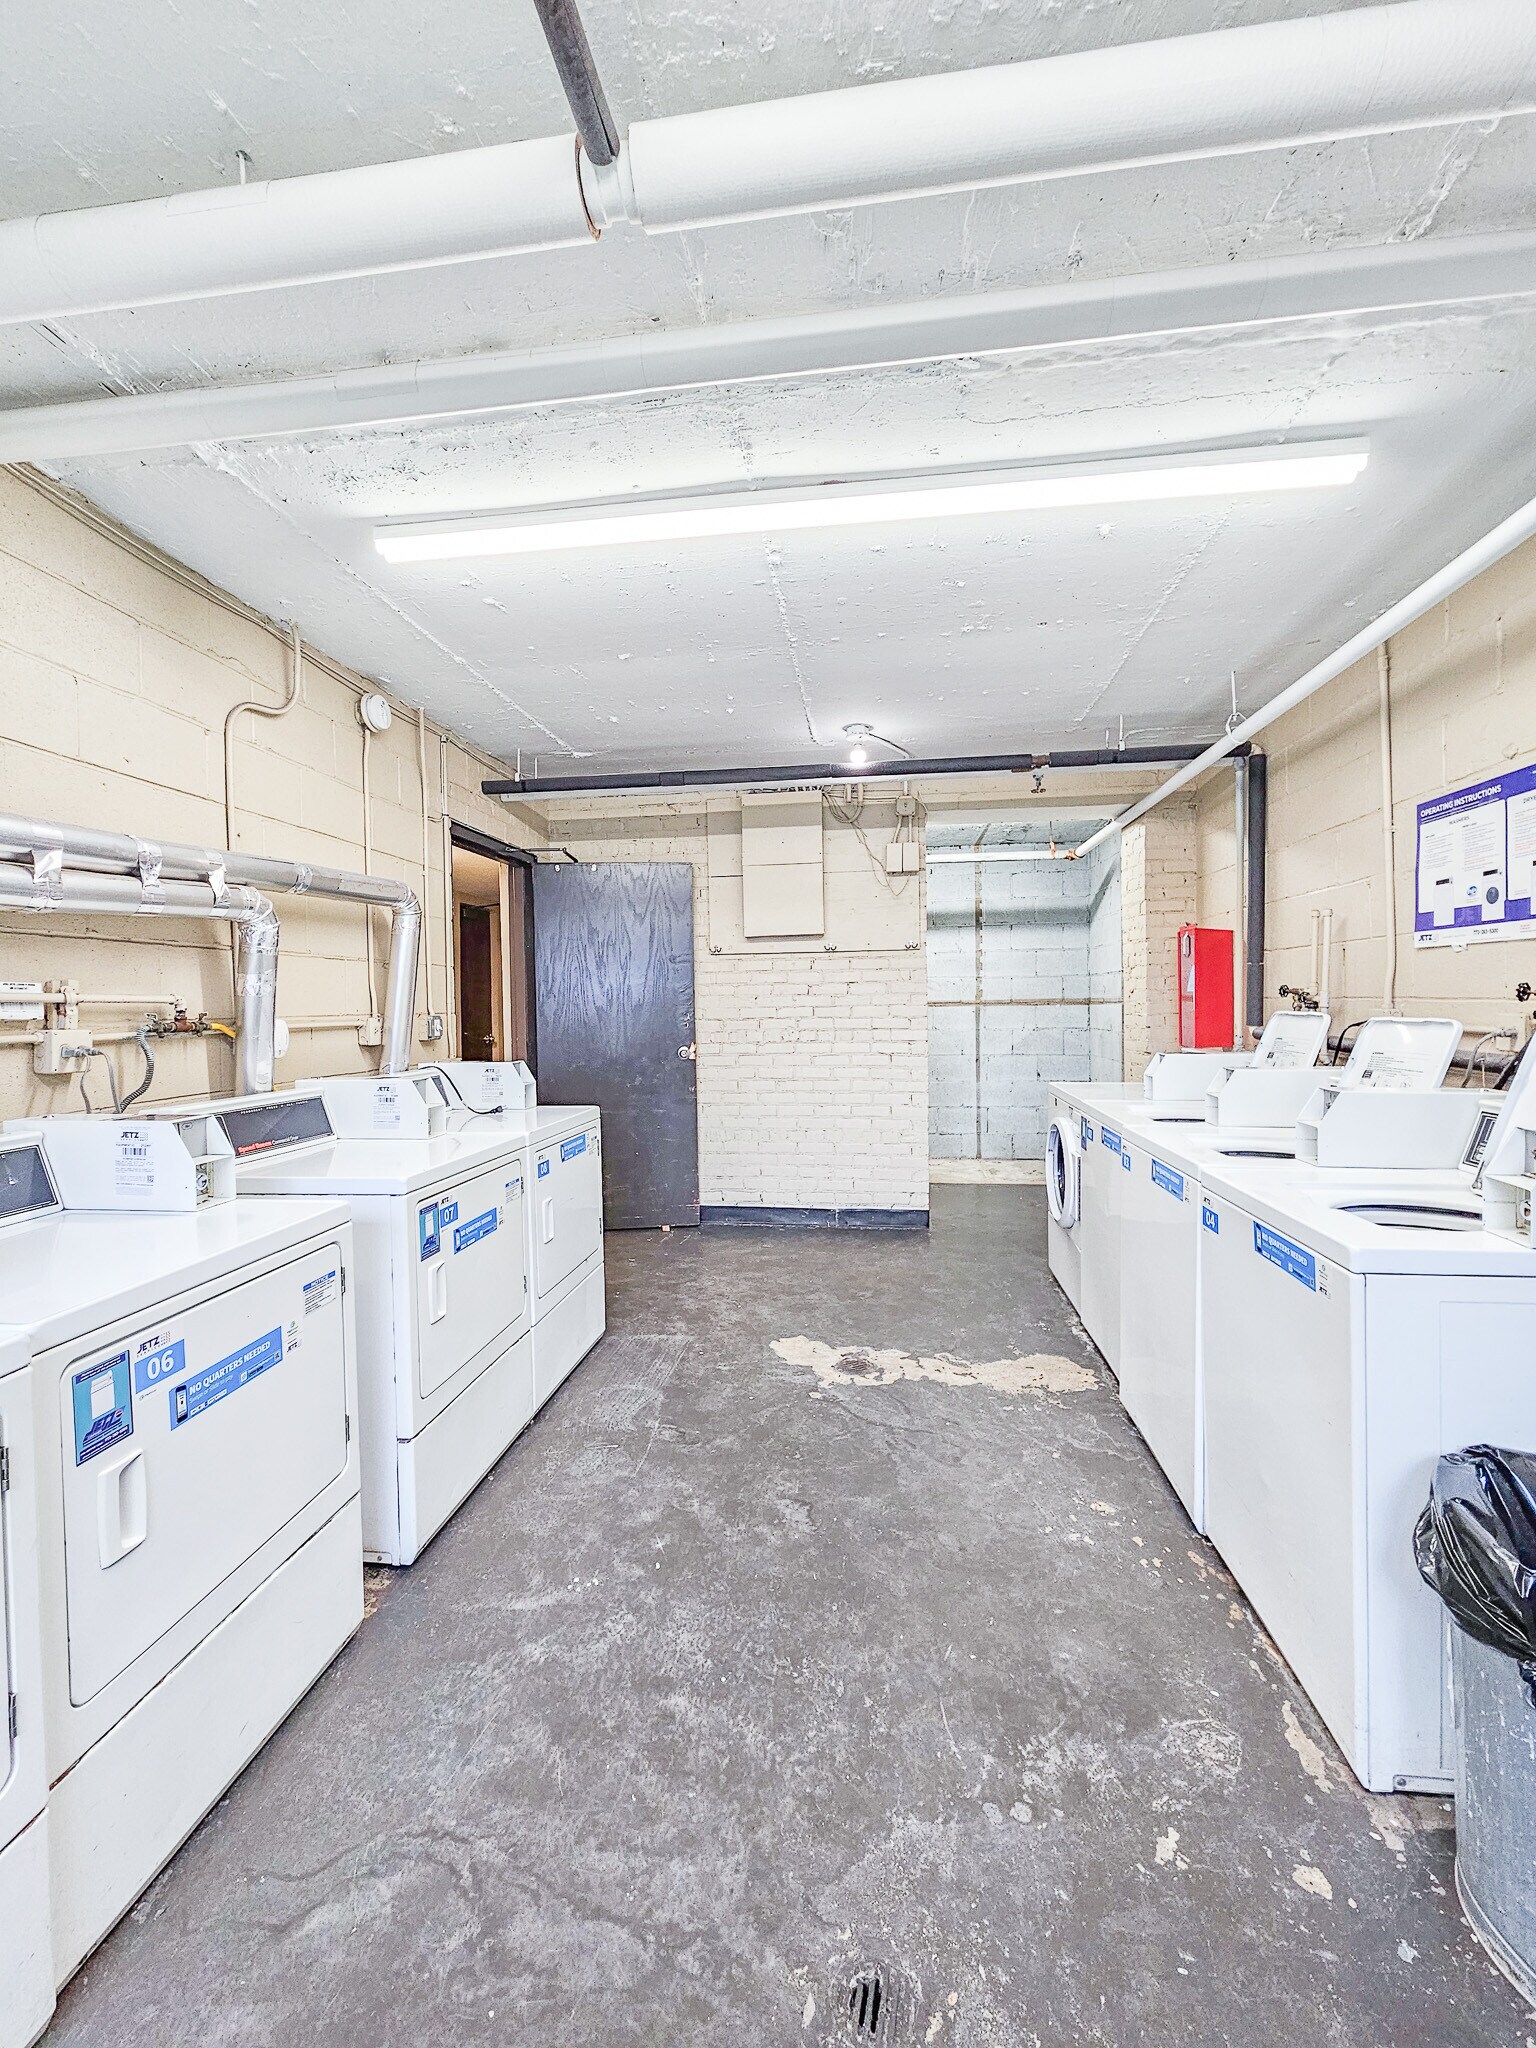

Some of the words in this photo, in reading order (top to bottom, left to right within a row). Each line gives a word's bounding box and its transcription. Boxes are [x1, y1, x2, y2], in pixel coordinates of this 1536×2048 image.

[1420, 801, 1453, 817] OPERATING
[1454, 784, 1502, 806] INSTRUCTIONS
[121, 1131, 139, 1139] JETZ
[444, 1206, 455, 1222] 07
[1205, 1211, 1215, 1228] 04
[137, 1335, 160, 1355] JETZ
[147, 1349, 175, 1380] 06
[188, 1381, 202, 1395] NO
[202, 1357, 243, 1388] QUARTERS
[243, 1341, 271, 1363] NEEDED
